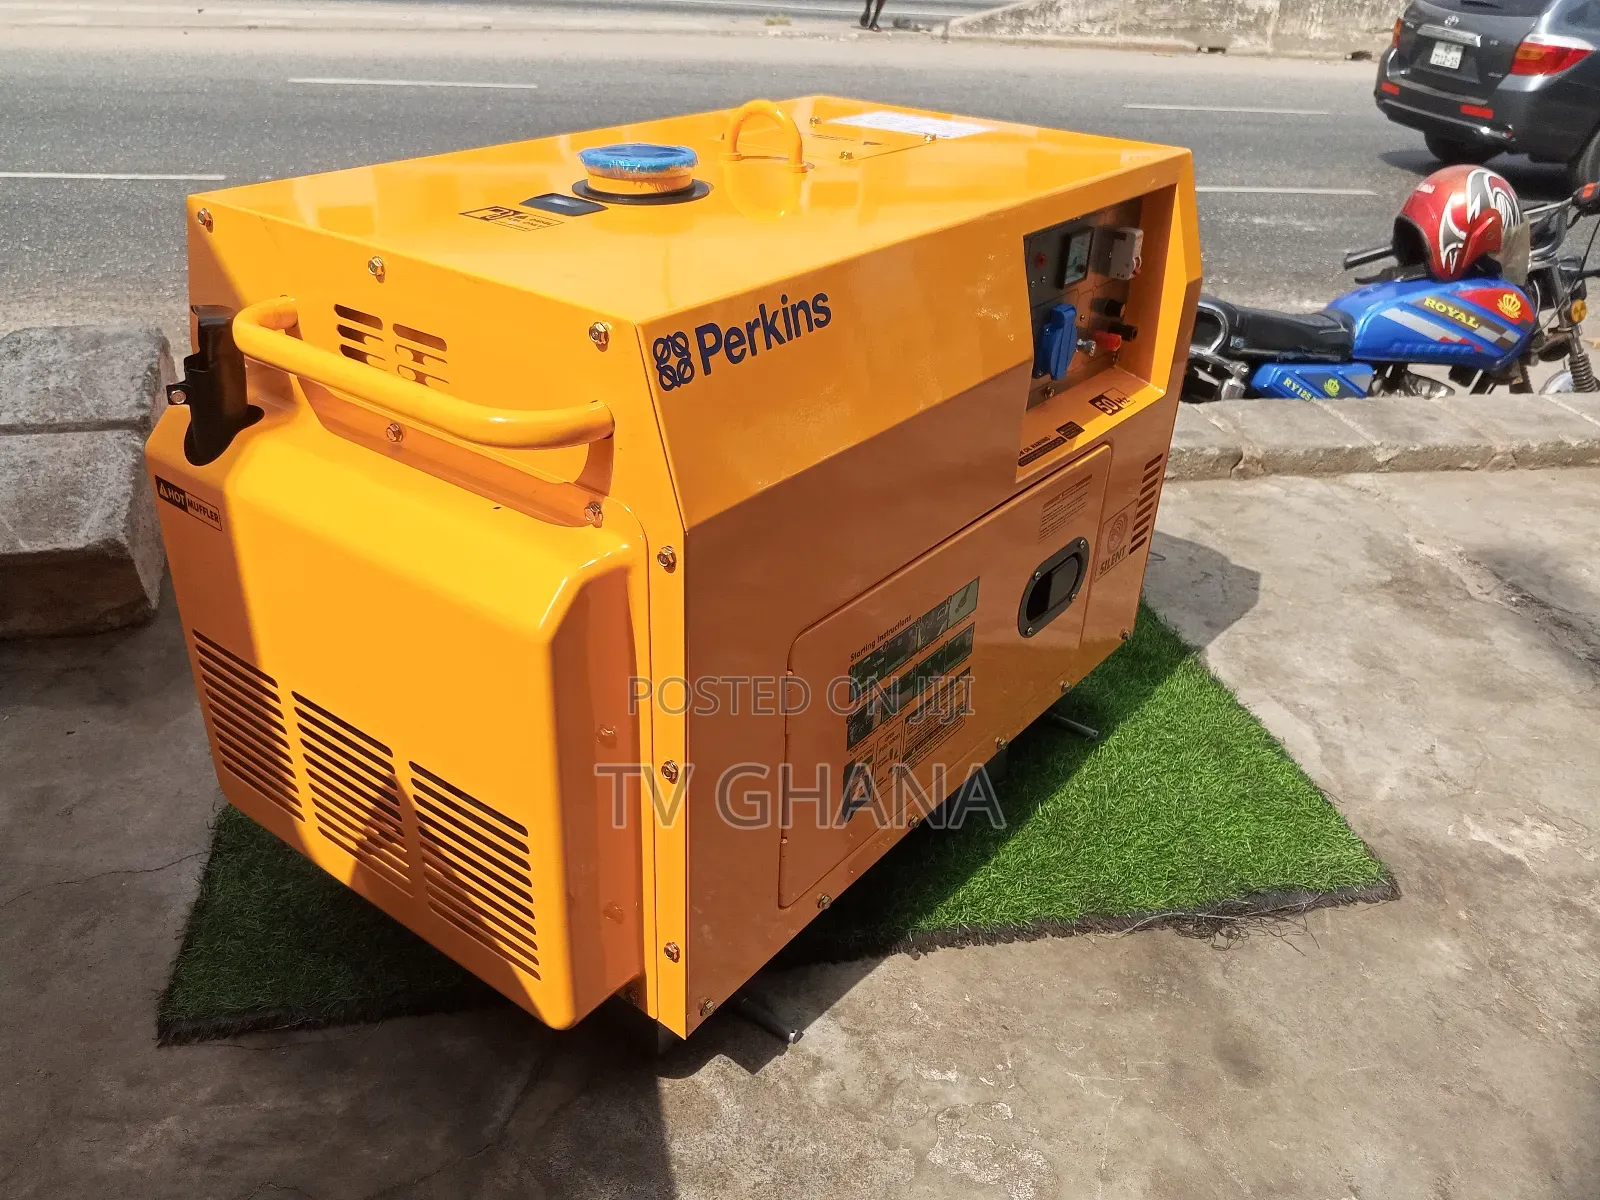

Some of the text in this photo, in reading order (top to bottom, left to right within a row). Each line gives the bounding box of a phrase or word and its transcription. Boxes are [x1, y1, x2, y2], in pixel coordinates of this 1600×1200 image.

[1423, 296, 1480, 329] ROYAL
[694, 292, 832, 377] Perkins
[1094, 396, 1129, 415] 50 Hz
[168, 487, 219, 523] HOT MUFFLER
[1099, 544, 1127, 576] SILENT
[850, 614, 912, 663] Starting Instructions
